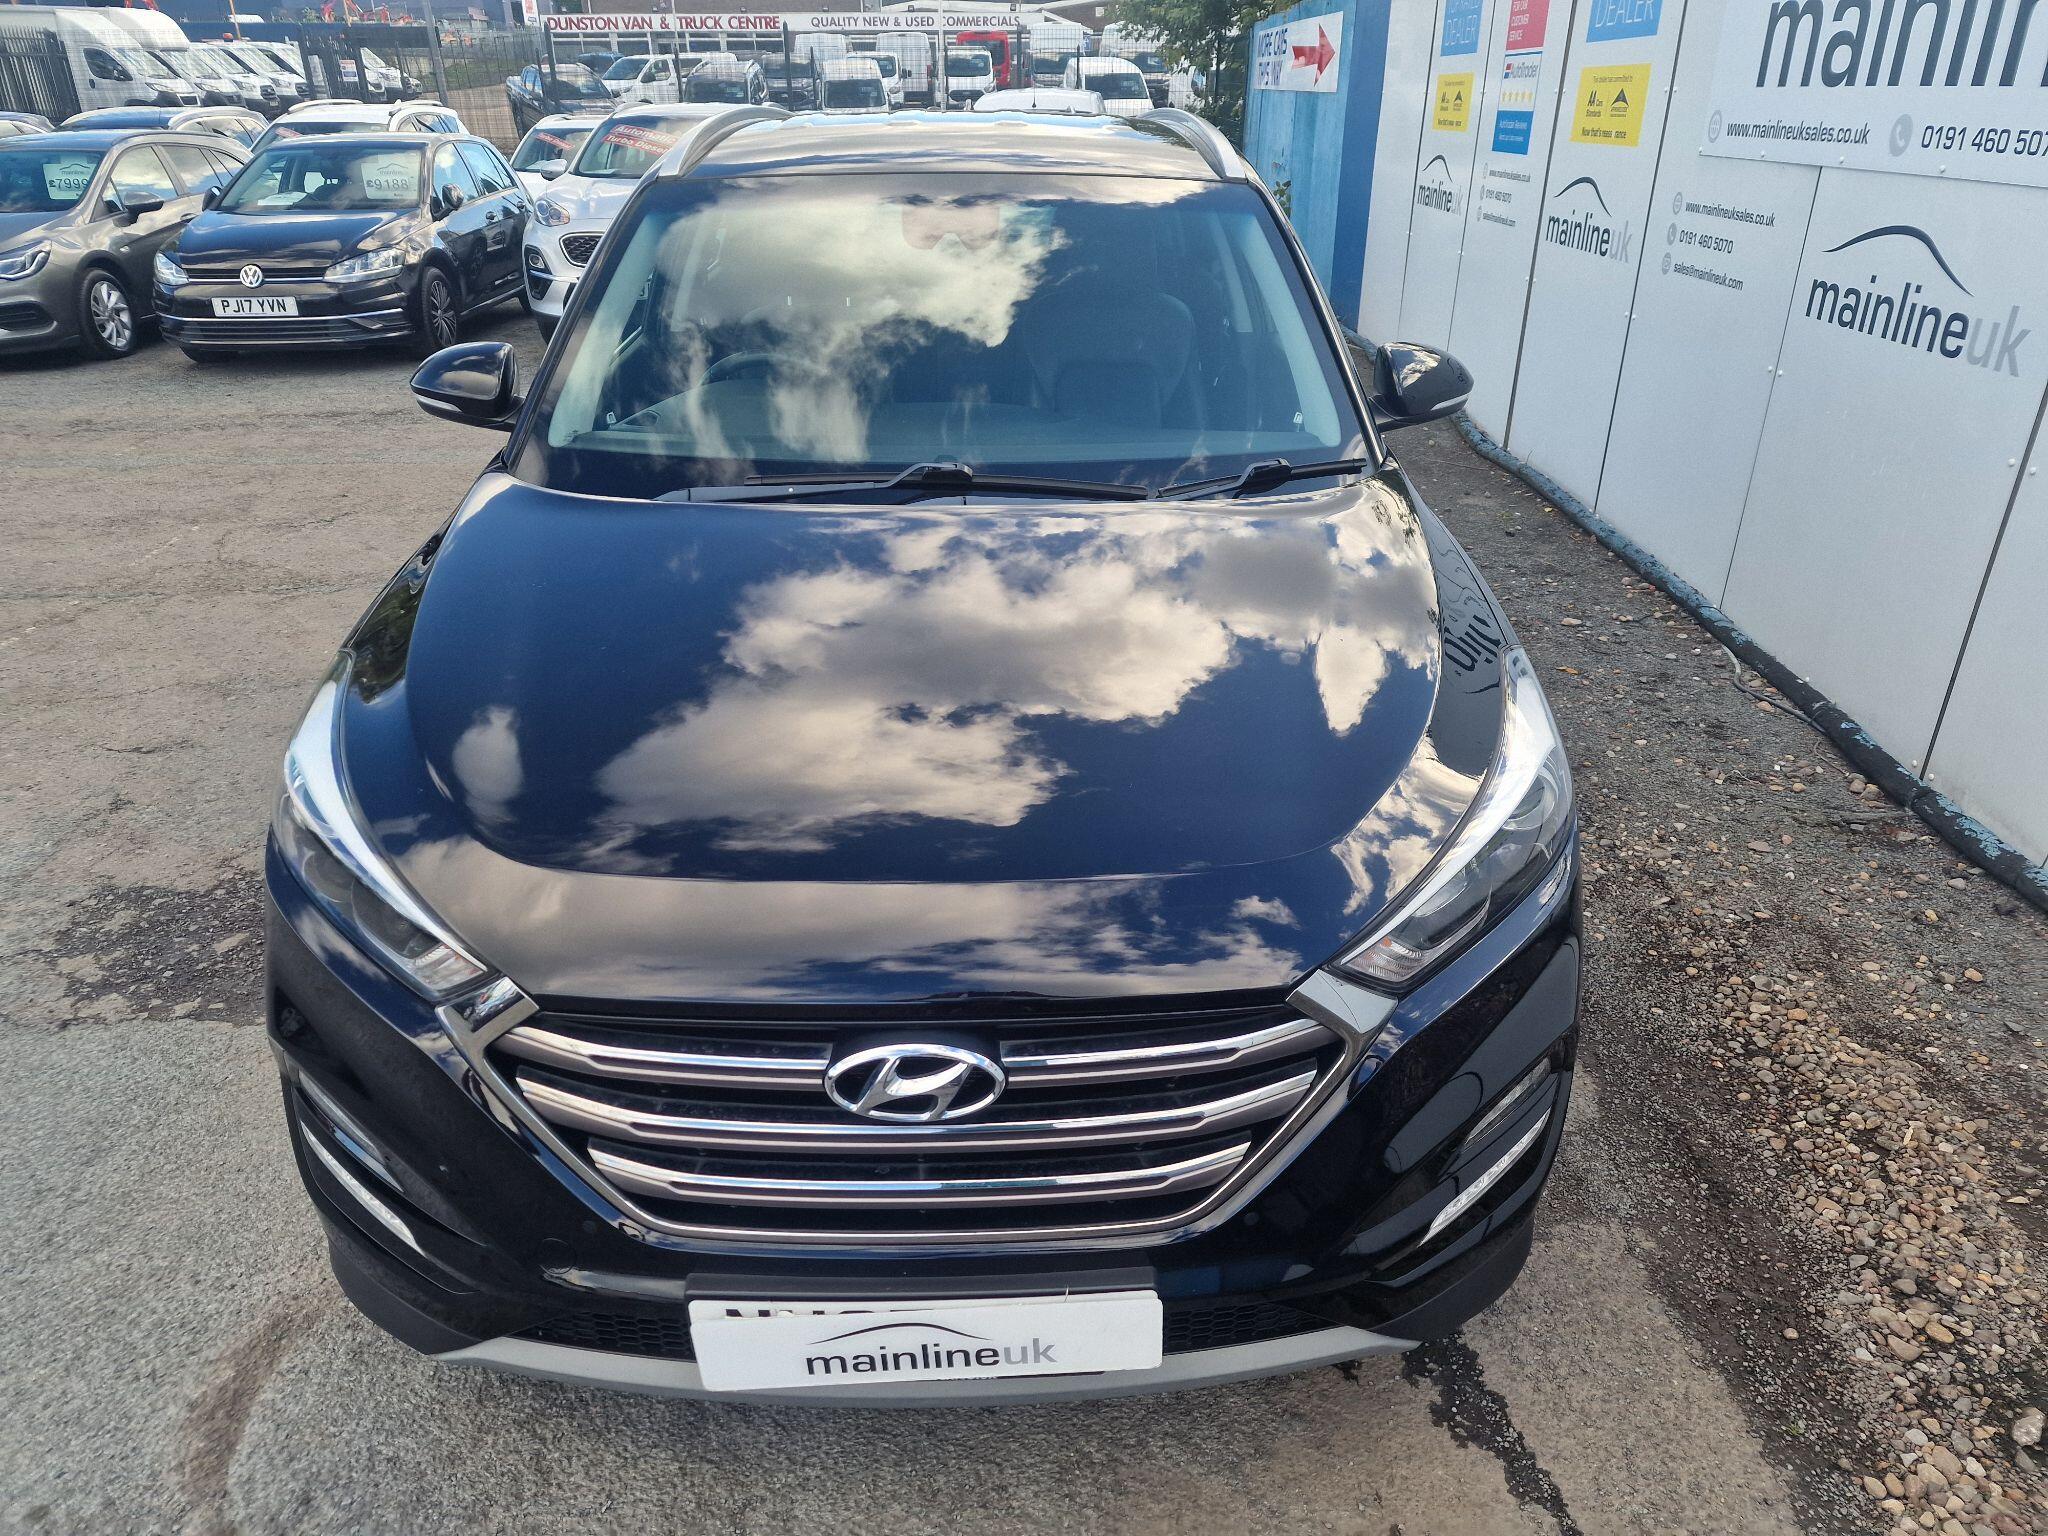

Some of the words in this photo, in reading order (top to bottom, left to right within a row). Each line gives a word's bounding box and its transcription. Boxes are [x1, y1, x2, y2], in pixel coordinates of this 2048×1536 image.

[547, 16, 619, 30] DUNSTON
[620, 16, 653, 30] VAN
[660, 15, 670, 30] &
[677, 16, 723, 29] TRUCK
[728, 16, 780, 30] CENTRE
[811, 16, 860, 28] QUALITY
[863, 17, 890, 27] NEW
[893, 16, 901, 27] &
[905, 16, 935, 27] USED
[1595, 0, 1655, 27] DEALER
[607, 134, 633, 145] Turbo
[636, 139, 668, 154] Diesel
[615, 125, 677, 145] Automatic
[1726, 119, 1870, 146] www.mainlineuksales.co.uk
[1921, 124, 1968, 151] 0191
[1970, 127, 2012, 154] 460
[1417, 179, 1463, 216] mainlineuk
[1685, 200, 1775, 228] www.mainlineuksales.co.uk
[1546, 209, 1633, 263] mainlineuk
[1679, 229, 1698, 246] 0191
[1698, 233, 1713, 249] 460
[1713, 236, 1734, 254] 5070
[1673, 261, 1744, 291] sales@mainlineuk.com
[221, 299, 252, 313] PJ17
[257, 299, 287, 313] YVN
[1805, 274, 2032, 378] mainlineuk
[806, 1337, 1058, 1376] mainlineuk
